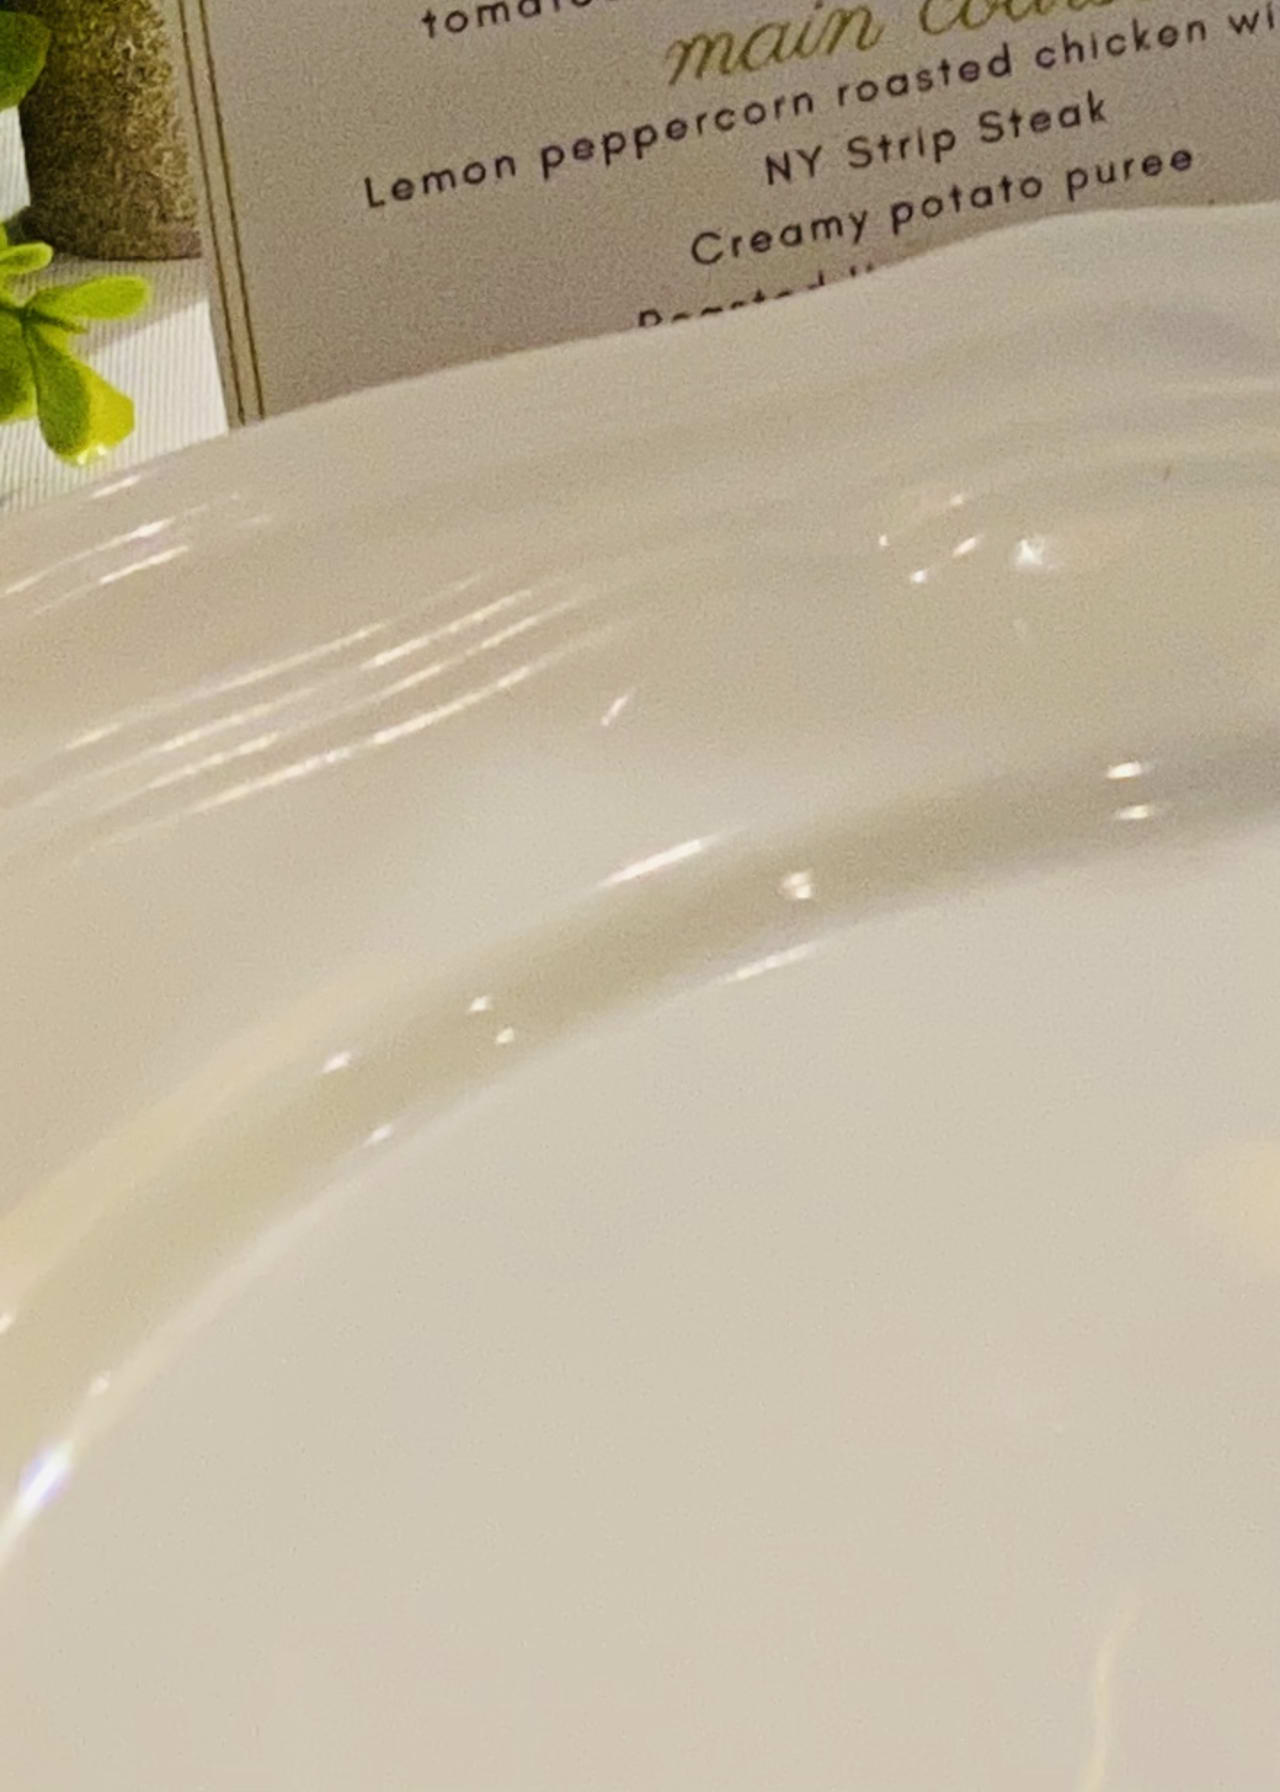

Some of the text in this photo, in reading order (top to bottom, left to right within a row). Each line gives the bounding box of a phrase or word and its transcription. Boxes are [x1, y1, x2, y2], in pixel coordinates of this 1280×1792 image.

[363, 153, 517, 210] Lemon
[541, 91, 815, 180] peppercorn
[838, 42, 1013, 107] roasted
[1035, 17, 1207, 69] chicken
[765, 89, 1107, 186] NY Strip Steak
[691, 149, 1193, 266] Creamy potato puree
